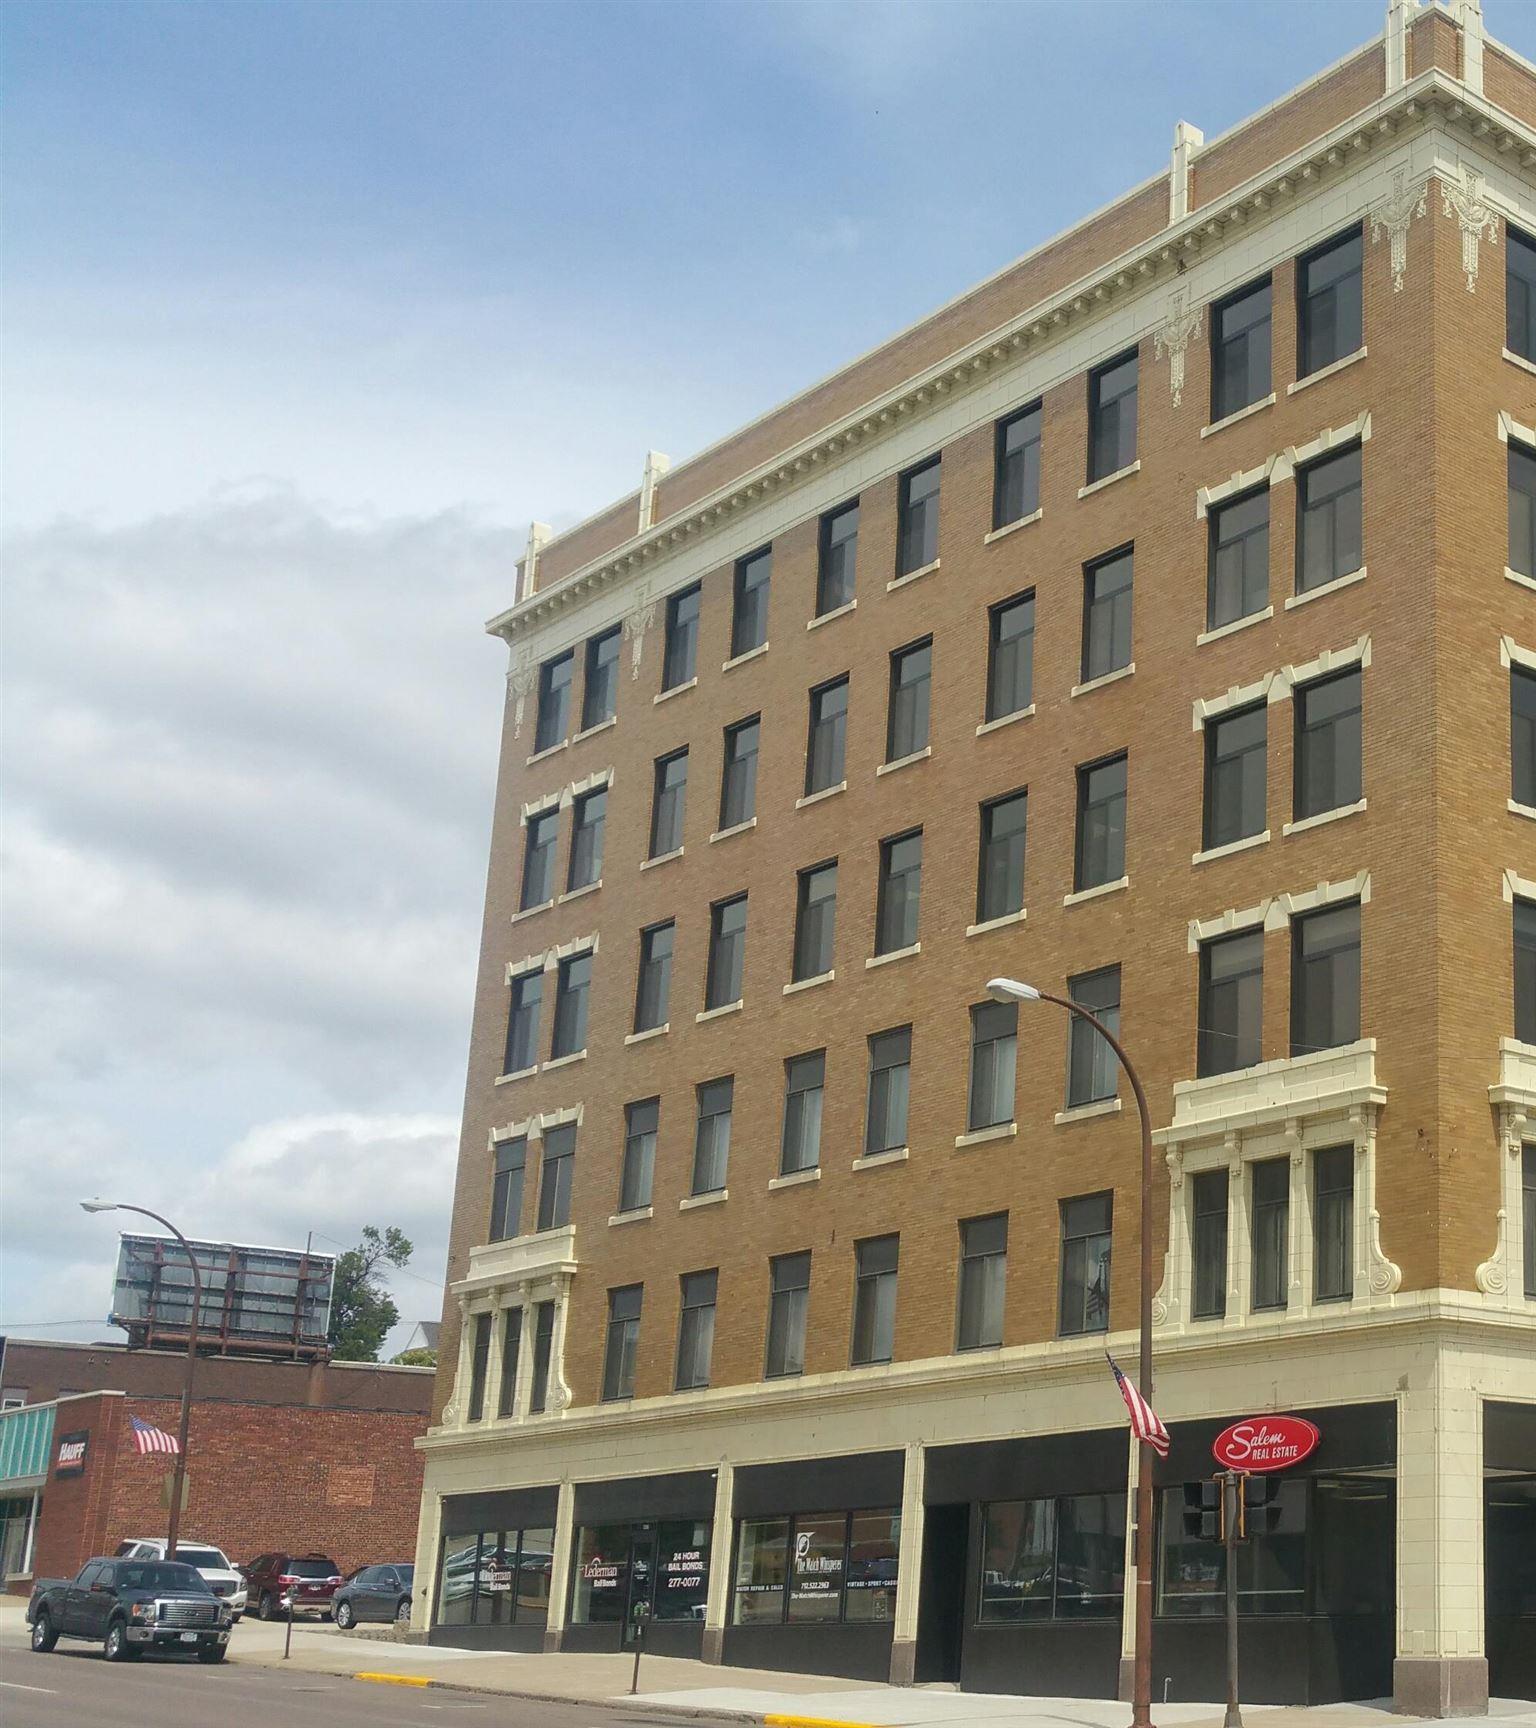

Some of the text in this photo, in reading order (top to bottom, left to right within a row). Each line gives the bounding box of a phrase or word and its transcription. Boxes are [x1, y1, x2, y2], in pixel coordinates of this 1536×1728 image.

[1226, 1426, 1285, 1459] Salem
[59, 1442, 85, 1461] HAUFF
[1252, 1445, 1298, 1460] REAL ESTATE
[673, 1552, 700, 1561] 24 HOUR
[584, 1564, 617, 1577] Lederman
[667, 1562, 703, 1571] BAIL BONDS
[797, 1558, 805, 1572] The
[667, 1577, 700, 1588] 277-0077
